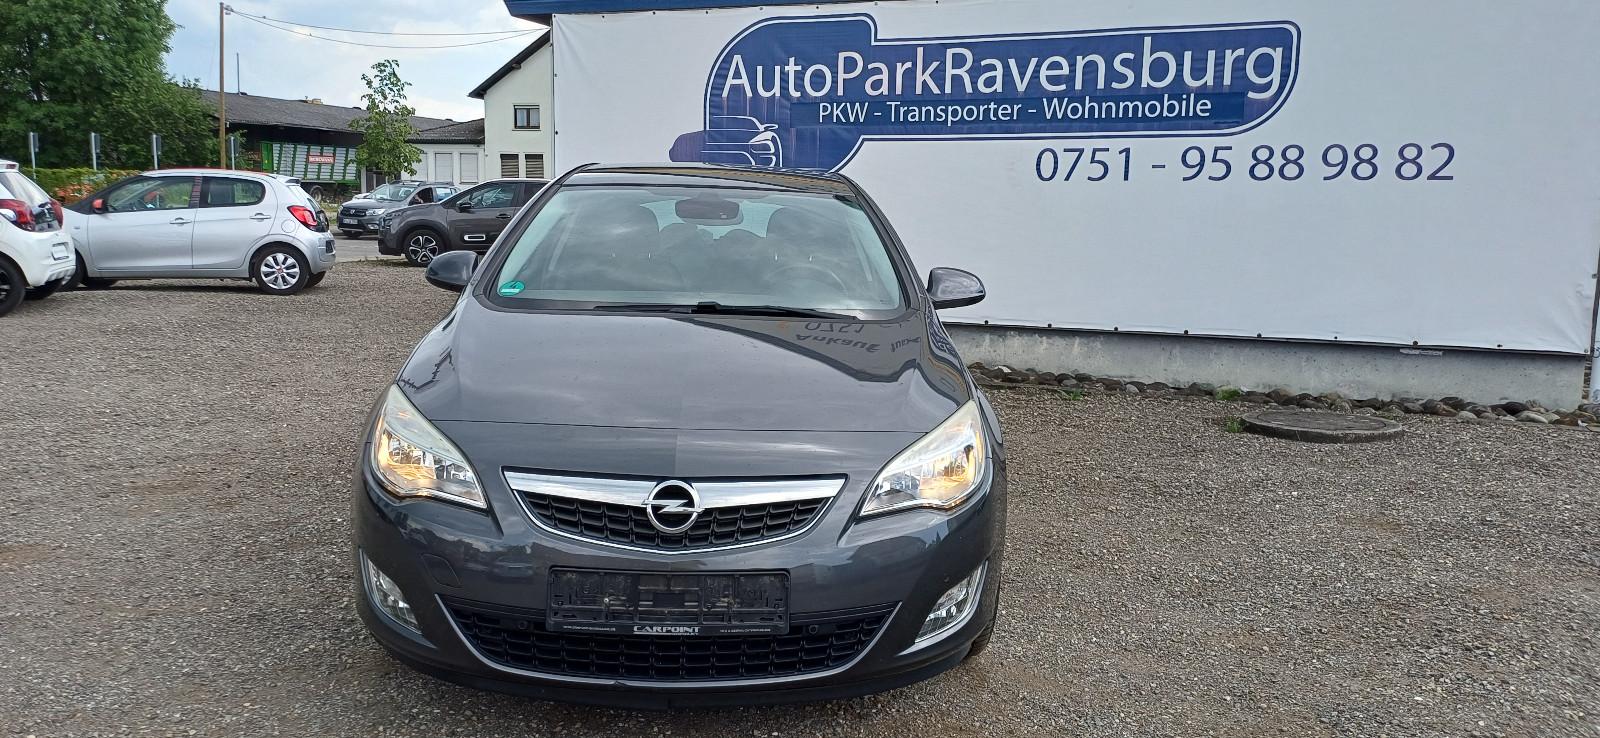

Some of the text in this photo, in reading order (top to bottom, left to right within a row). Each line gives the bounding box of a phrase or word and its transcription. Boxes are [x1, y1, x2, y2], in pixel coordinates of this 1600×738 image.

[722, 37, 1283, 99] AutoParkRavensburg
[819, 102, 868, 123] PKW
[887, 97, 1021, 126] Transporter
[1043, 93, 1212, 120] Wohnmobile
[1035, 147, 1131, 182] 0751
[1181, 145, 1233, 182] 95
[1248, 144, 1305, 181] 88
[1321, 143, 1379, 181] 98
[1395, 142, 1455, 181] 82
[633, 625, 701, 633] CARPOINT
